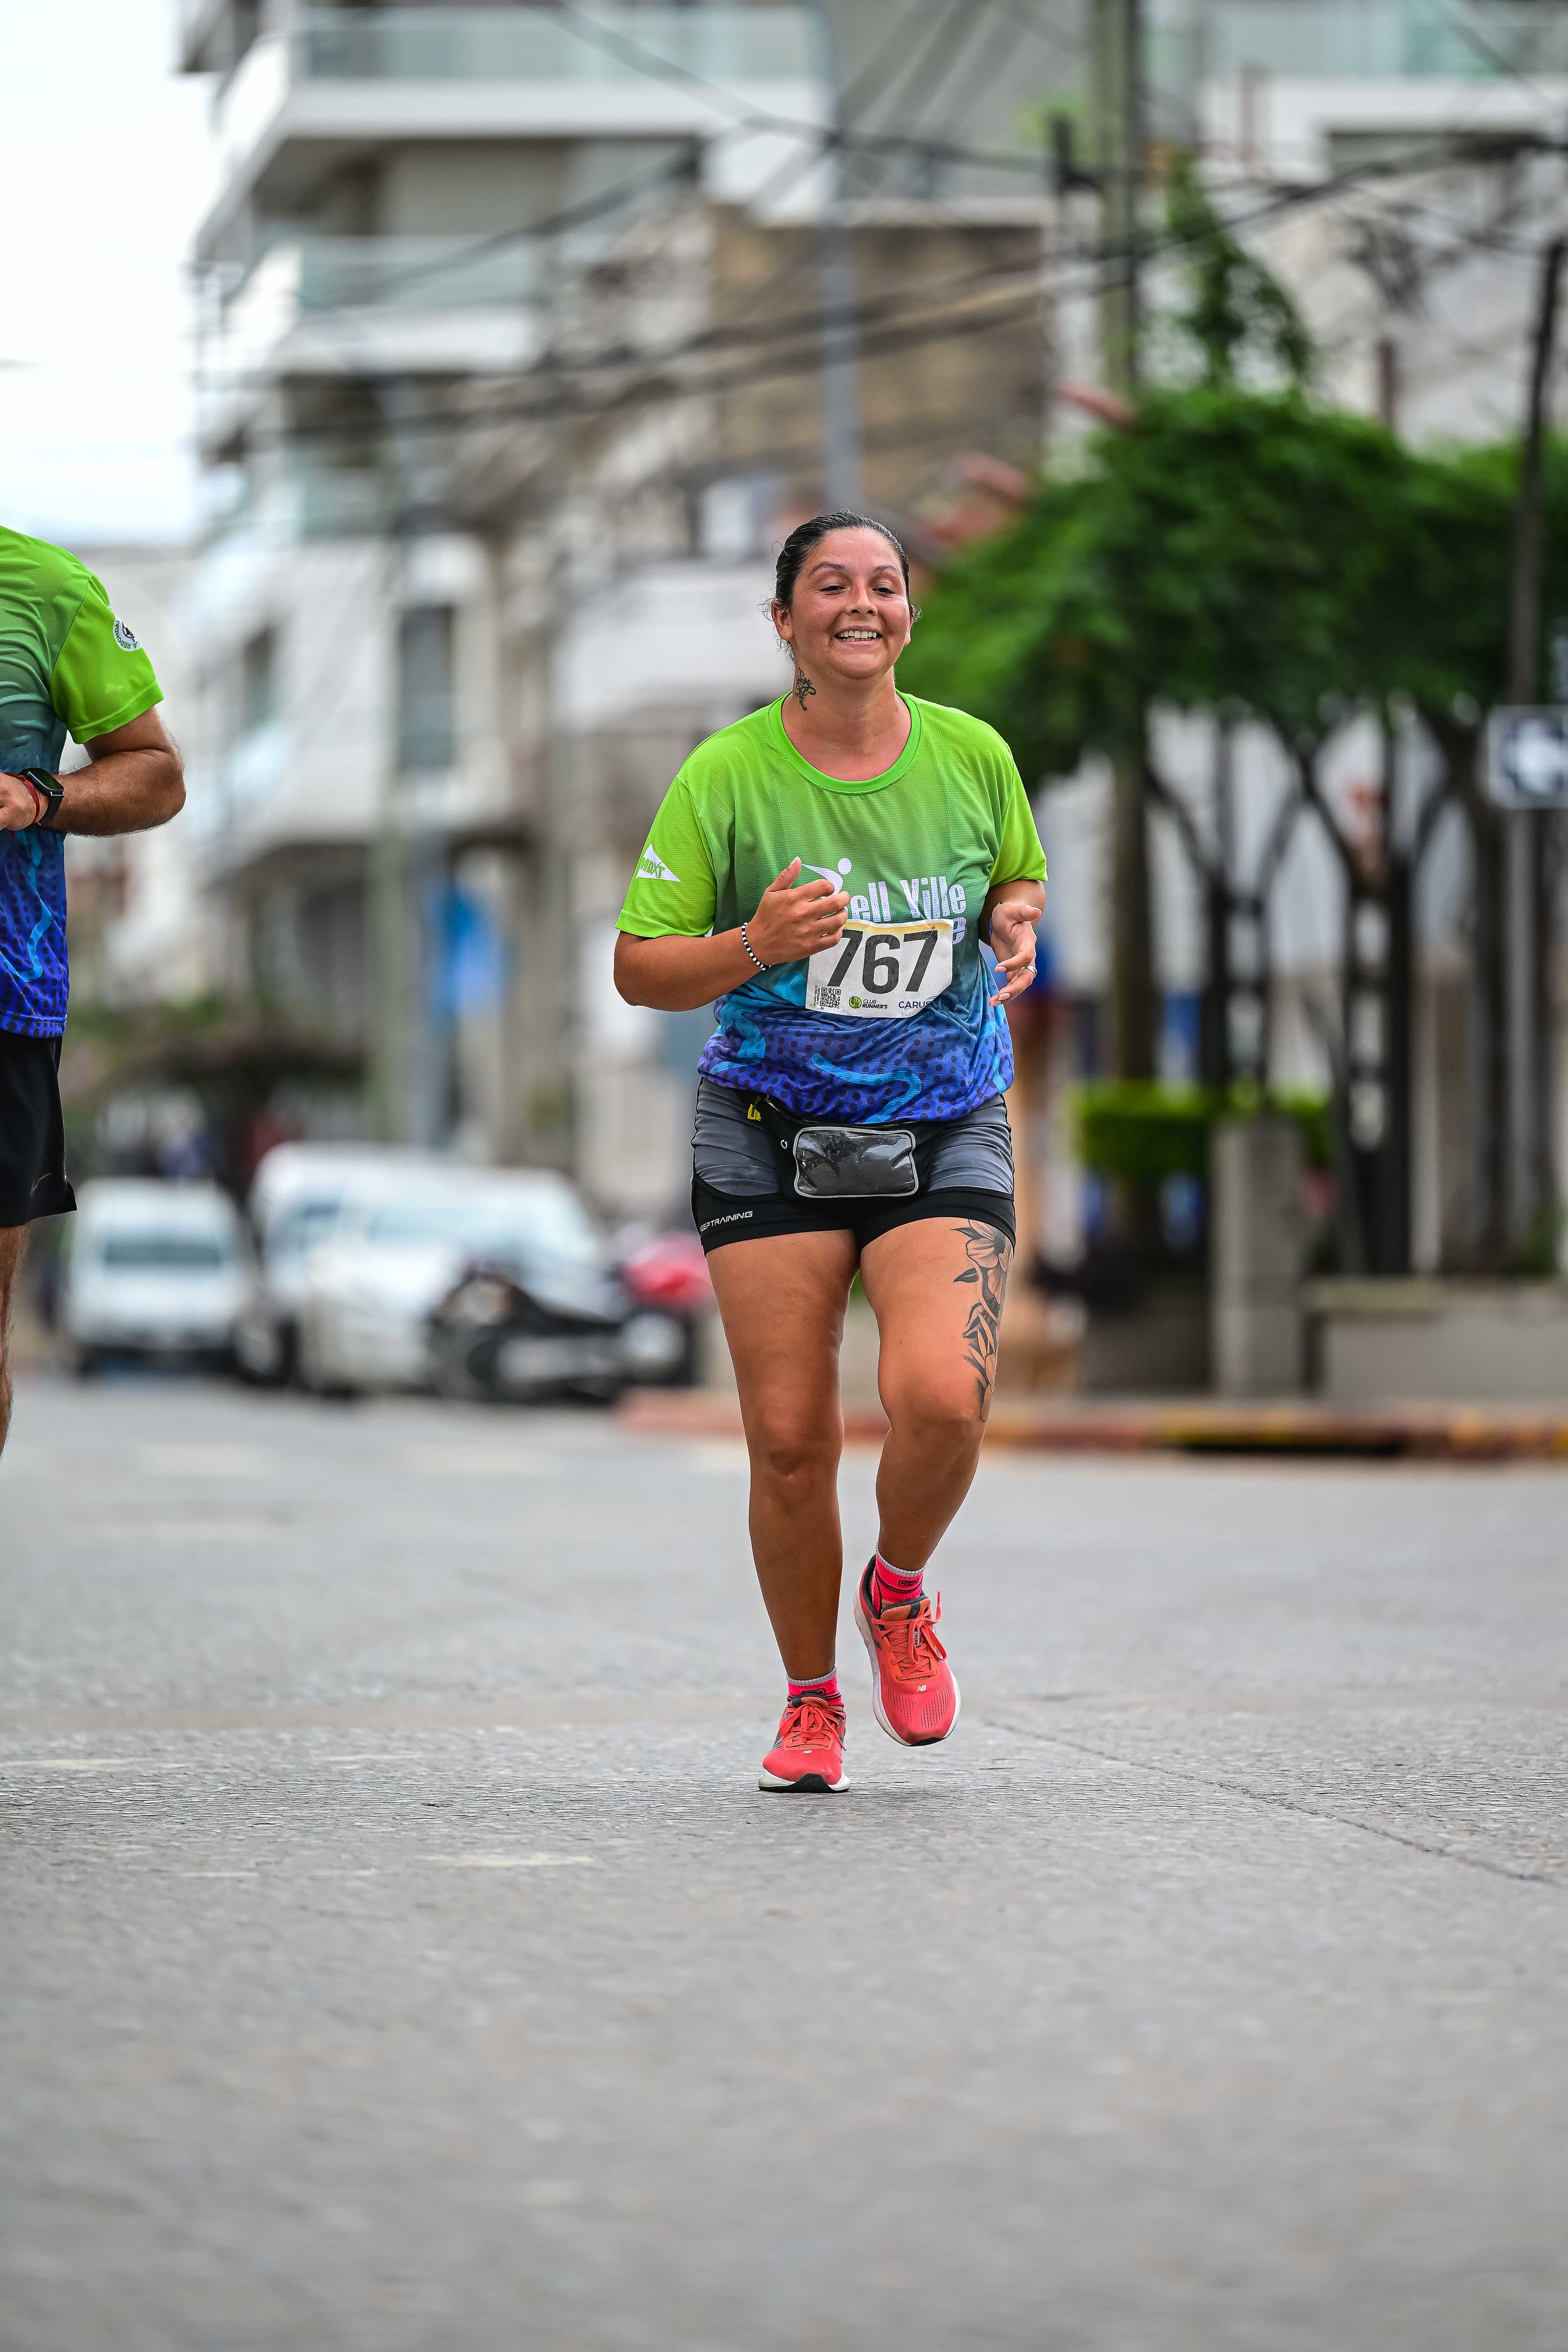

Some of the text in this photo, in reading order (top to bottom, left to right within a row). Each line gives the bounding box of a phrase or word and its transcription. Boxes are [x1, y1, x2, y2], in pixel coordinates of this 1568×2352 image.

[845, 876, 966, 922] ell Ville
[828, 929, 938, 994] 767
